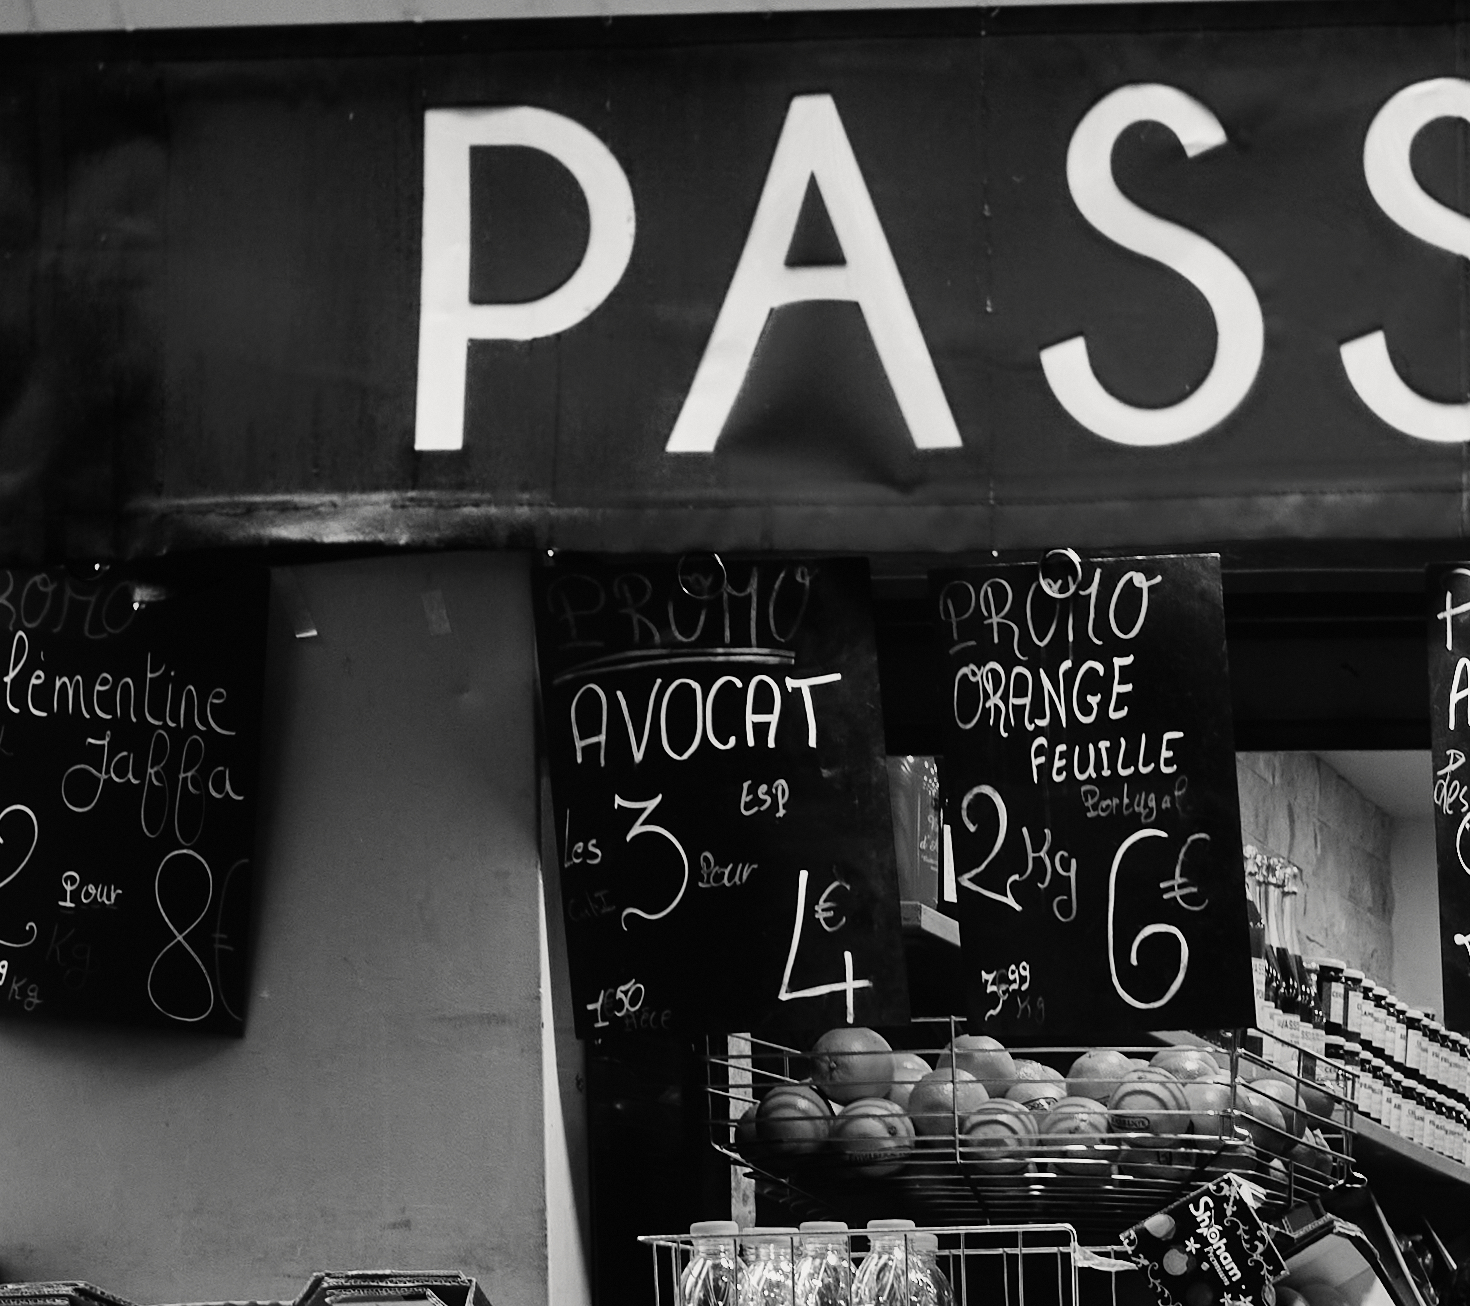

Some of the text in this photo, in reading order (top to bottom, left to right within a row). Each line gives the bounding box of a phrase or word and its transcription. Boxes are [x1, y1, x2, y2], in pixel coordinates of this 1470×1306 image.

[570, 672, 842, 767] AVOCAT
[952, 655, 1135, 737] ORANGE
[1030, 730, 1185, 785] FEUILLE
[59, 871, 124, 909] Pour
[613, 792, 690, 932] 3
